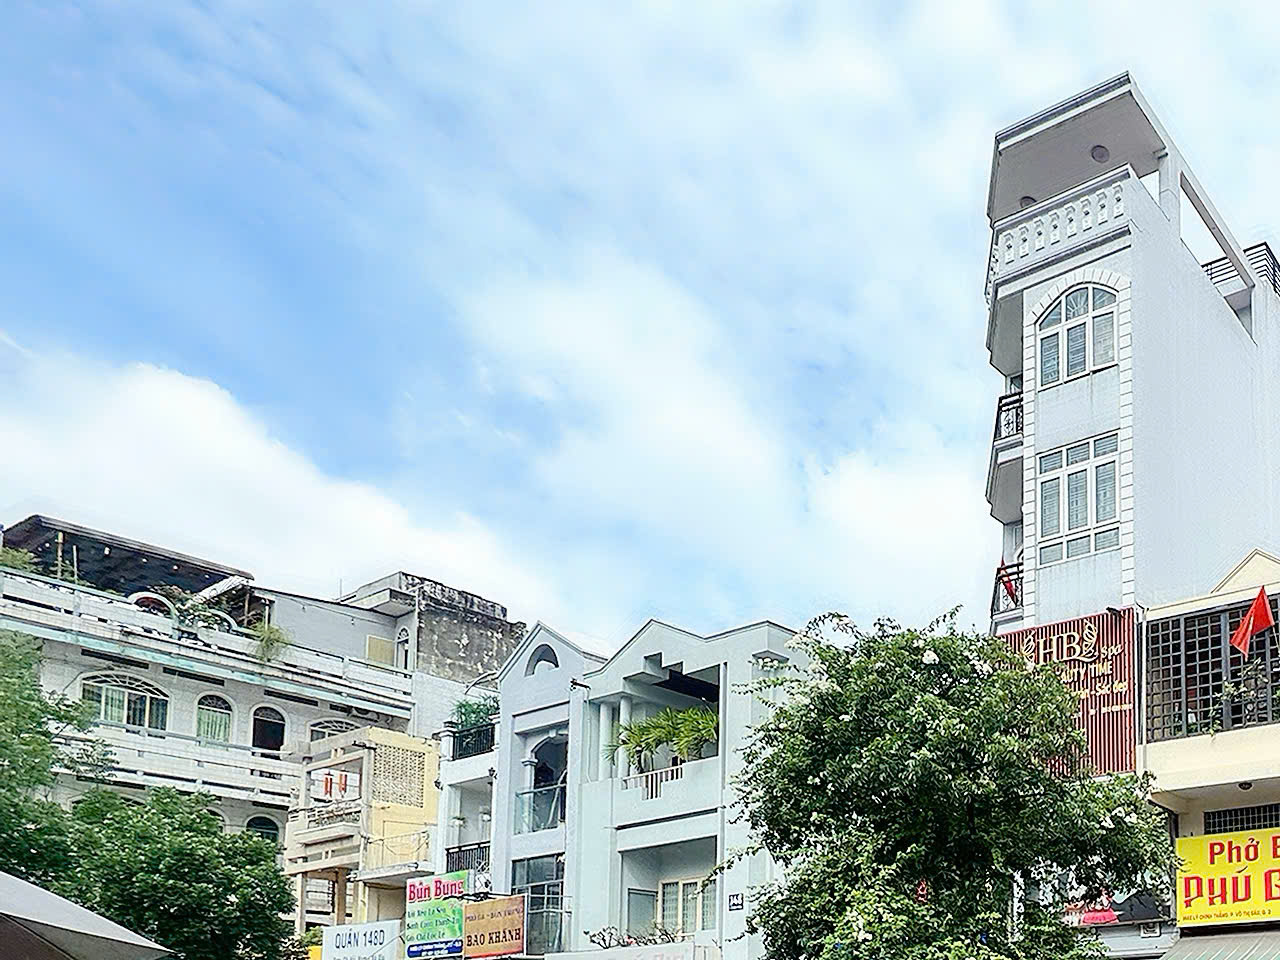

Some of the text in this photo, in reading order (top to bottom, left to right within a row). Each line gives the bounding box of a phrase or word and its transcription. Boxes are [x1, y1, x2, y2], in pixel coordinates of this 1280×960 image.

[1208, 837, 1261, 865] Phở
[408, 881, 431, 901] Bún
[1183, 865, 1252, 908] PHÚ
[335, 927, 360, 949] QUÁN
[363, 929, 385, 947] 148D
